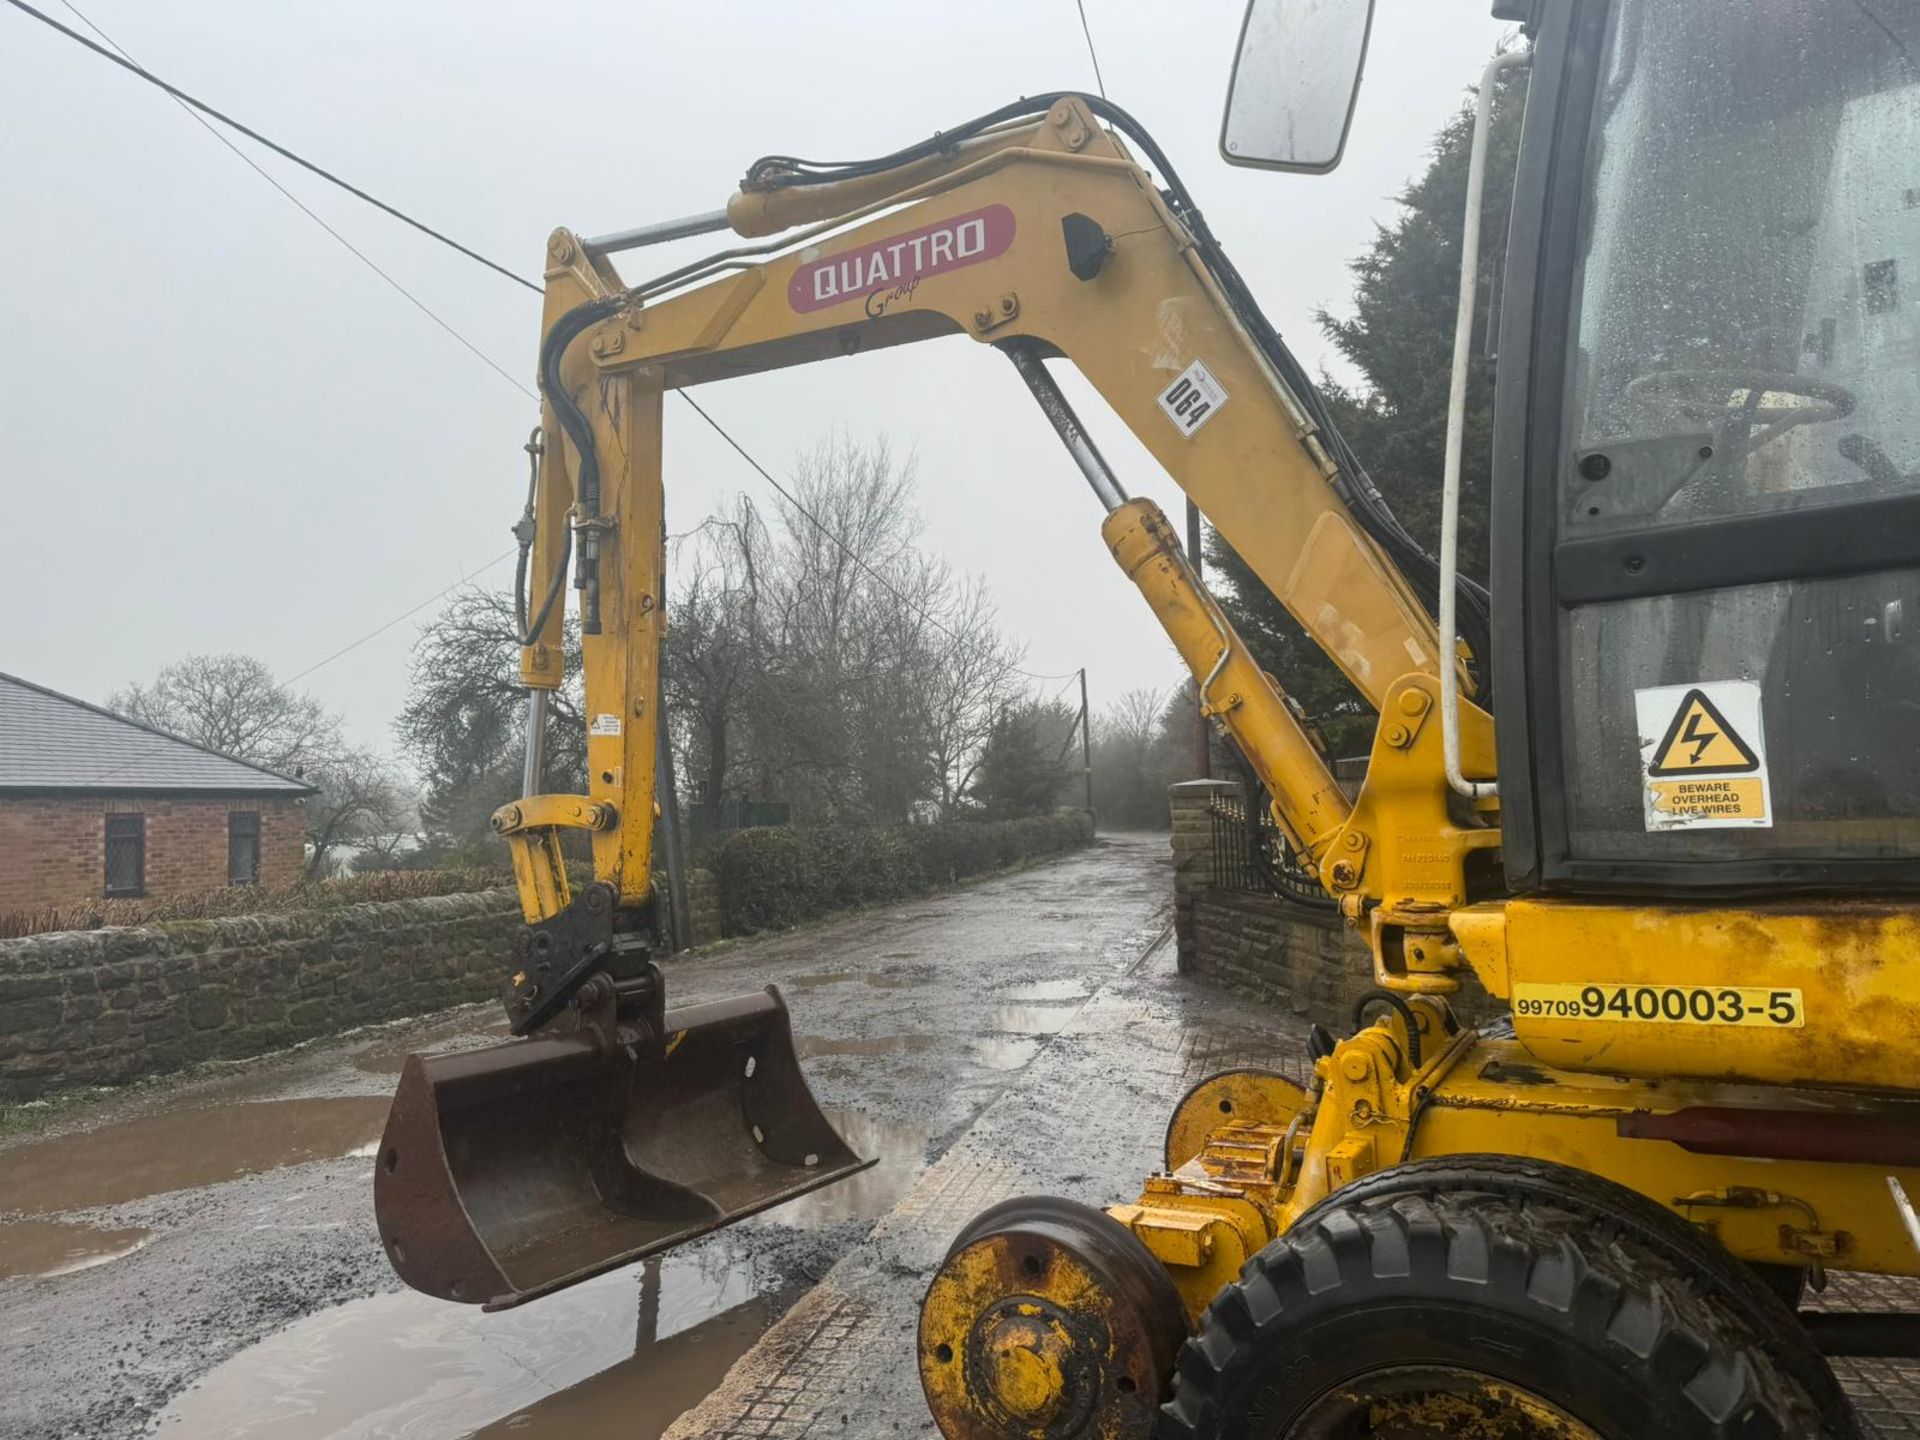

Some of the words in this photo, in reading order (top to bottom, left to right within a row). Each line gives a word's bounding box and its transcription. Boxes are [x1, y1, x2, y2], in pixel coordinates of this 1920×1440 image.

[814, 218, 985, 301] QUATTRO
[865, 275, 921, 319] Group
[1165, 377, 1211, 428] 064
[1672, 793, 1740, 805] OVERHEAD
[1678, 782, 1731, 793] BEWARE
[1672, 805, 1699, 816] LIVE
[1702, 804, 1742, 814] WIRES
